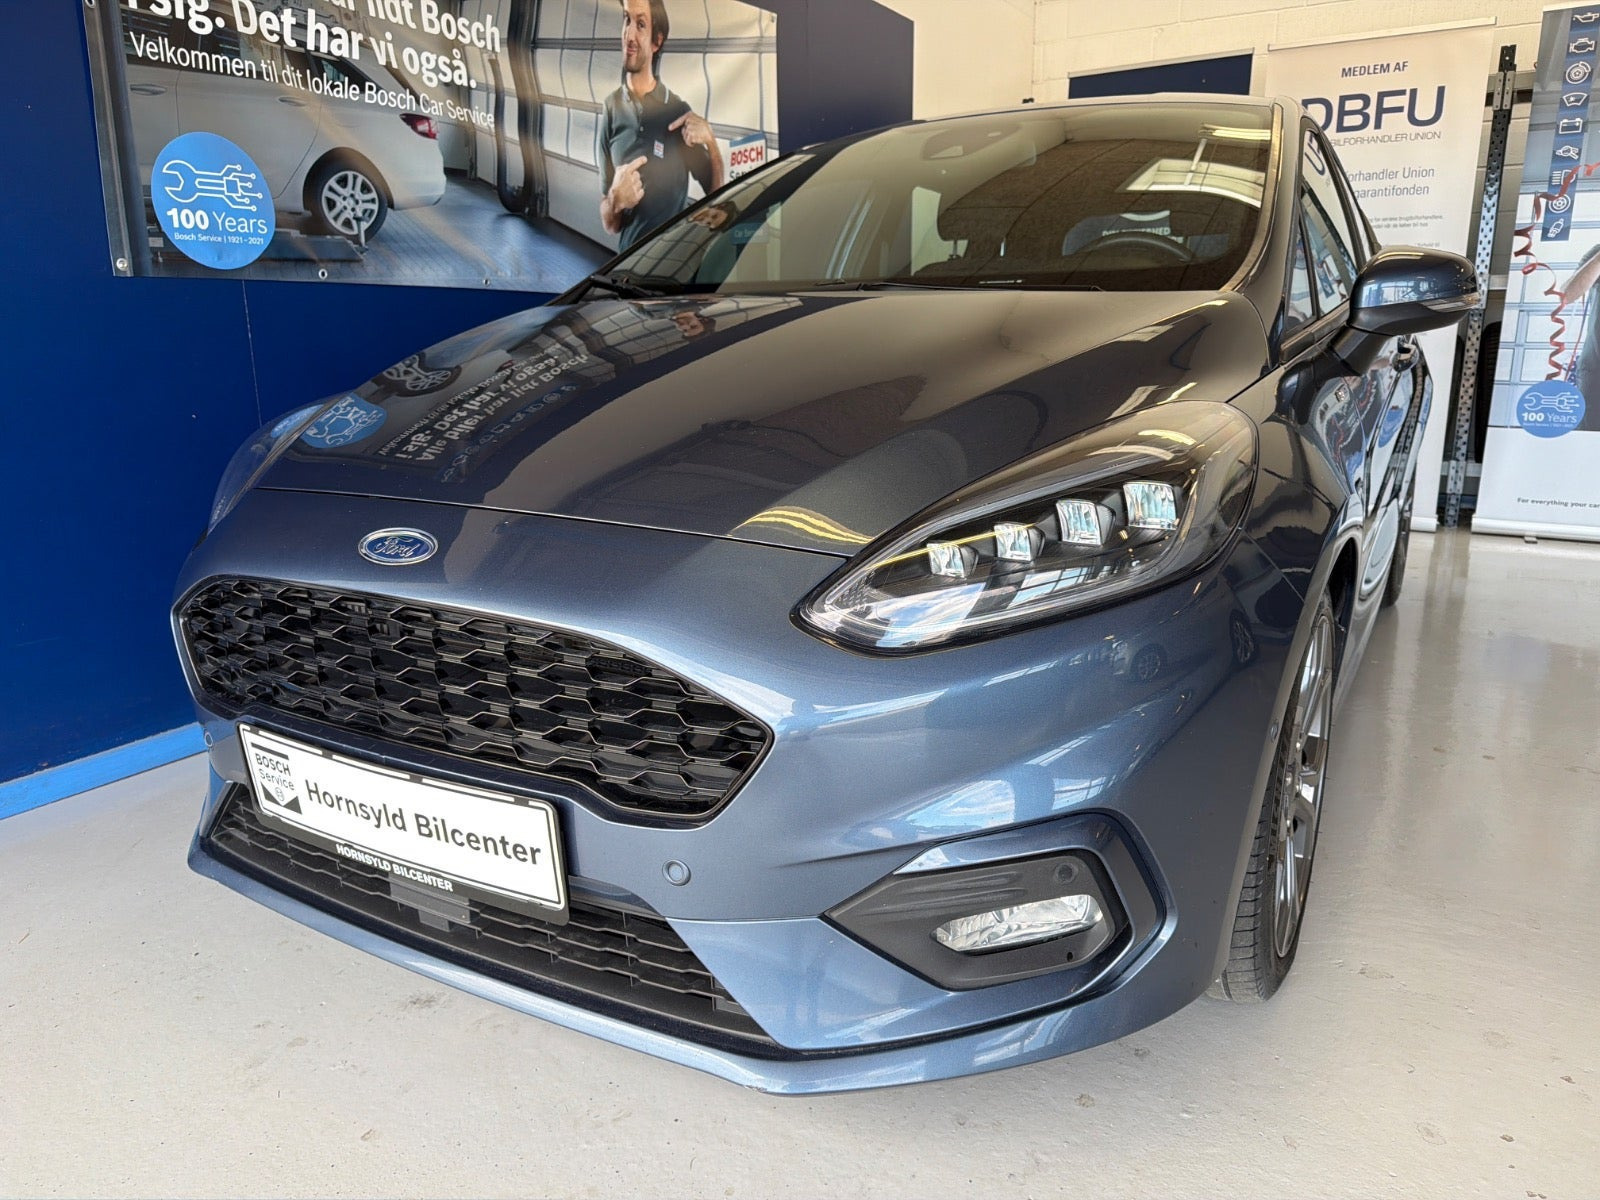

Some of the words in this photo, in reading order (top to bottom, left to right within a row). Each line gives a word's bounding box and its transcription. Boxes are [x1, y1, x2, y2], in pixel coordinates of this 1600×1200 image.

[420, 0, 501, 53] Bosch
[232, 0, 297, 48] Det
[306, 8, 364, 60] har
[369, 31, 399, 69] vi
[402, 48, 477, 88] også.
[129, 31, 257, 79] Velkommen
[260, 59, 279, 83] til
[282, 64, 304, 90] dit
[306, 69, 360, 101] lokale
[365, 82, 416, 111] Bosch
[419, 93, 444, 116] Car
[447, 100, 495, 128] Service
[1341, 62, 1390, 78] MEDLEM
[1393, 61, 1409, 73] AF
[1301, 85, 1446, 133] DBFU
[1409, 131, 1442, 141] UNION
[730, 146, 764, 167] BOSCH
[1346, 168, 1399, 183] orhandler
[1402, 166, 1435, 179] Union
[166, 207, 210, 230] 100
[212, 211, 268, 235] Years
[174, 232, 197, 241] Bosch
[198, 233, 222, 243] Service
[1522, 412, 1545, 422] 100
[1546, 413, 1578, 423] Years
[1531, 498, 1569, 507] everything
[373, 535, 421, 558] Ford
[255, 752, 291, 776] BOSCH
[259, 768, 295, 791] Service
[305, 779, 408, 833] Hornsyld
[414, 812, 542, 865] Bilcenter
[335, 843, 392, 871] HORNSYLD
[392, 863, 454, 892] BILCENTER
